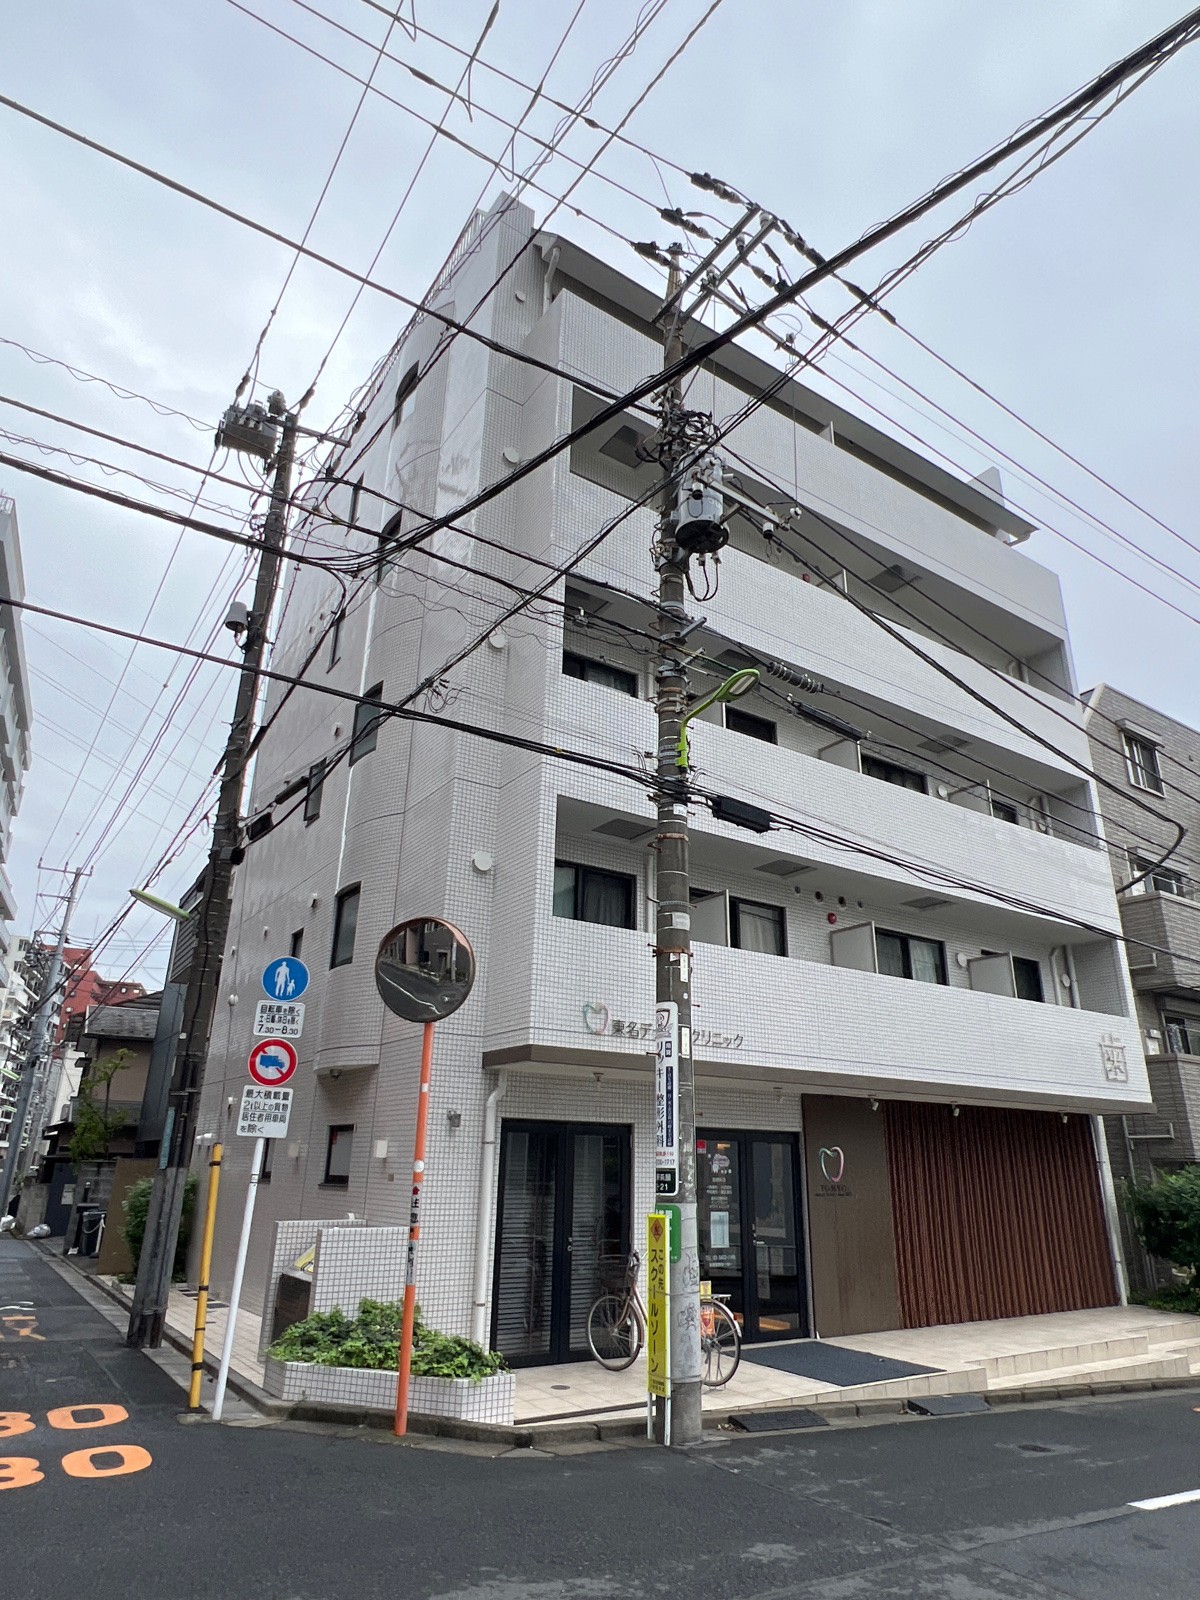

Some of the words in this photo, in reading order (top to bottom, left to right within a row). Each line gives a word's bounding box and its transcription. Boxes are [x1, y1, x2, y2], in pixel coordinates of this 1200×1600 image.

[245, 1089, 290, 1100] 最大積載量
[240, 1123, 265, 1134] を除く
